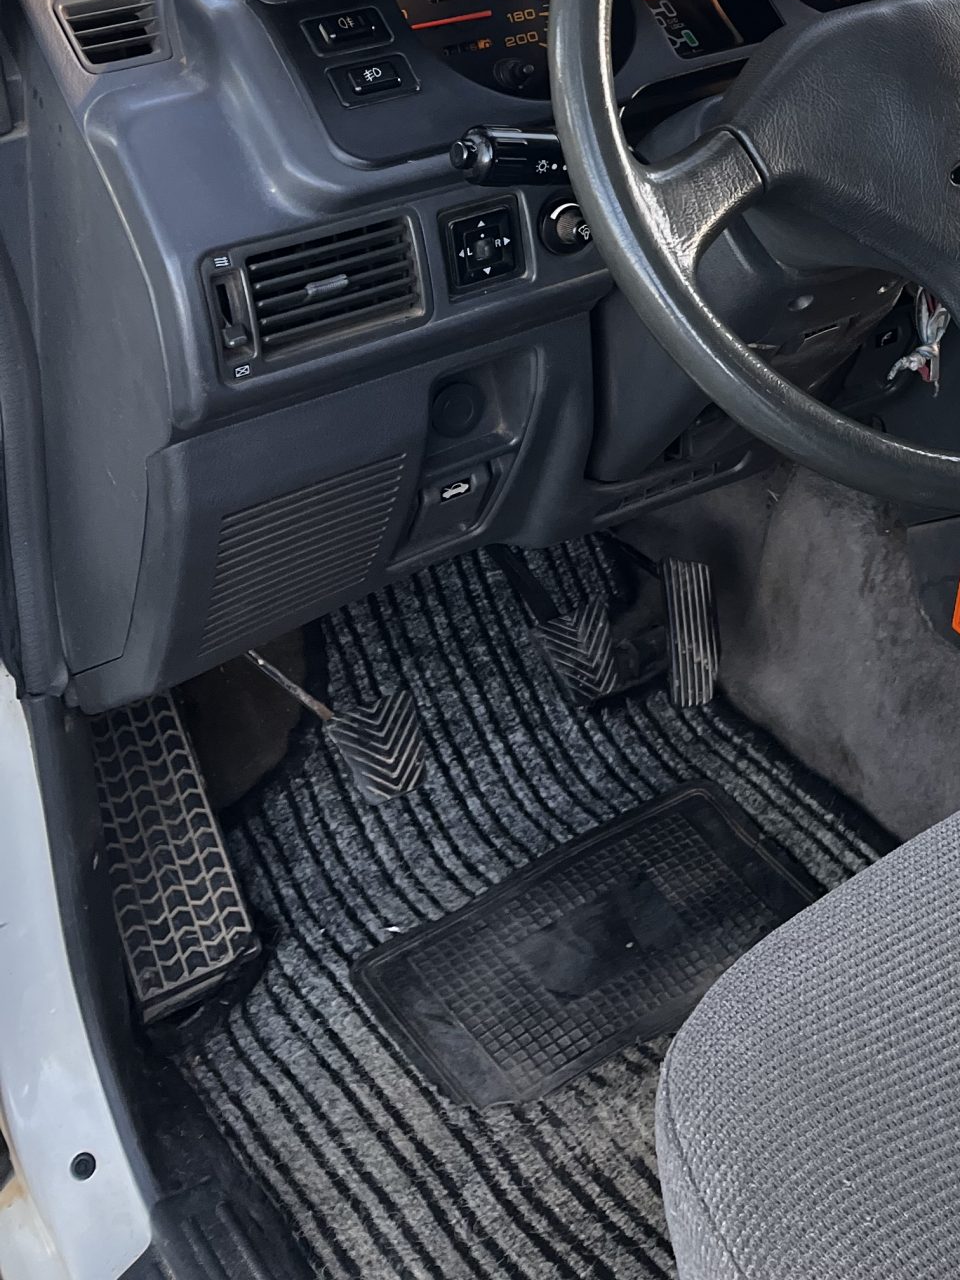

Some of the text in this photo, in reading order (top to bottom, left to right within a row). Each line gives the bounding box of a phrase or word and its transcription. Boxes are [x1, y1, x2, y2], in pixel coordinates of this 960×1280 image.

[506, 8, 536, 23] 180
[504, 31, 539, 48] 200
[494, 238, 502, 248] R
[466, 247, 473, 257] L
